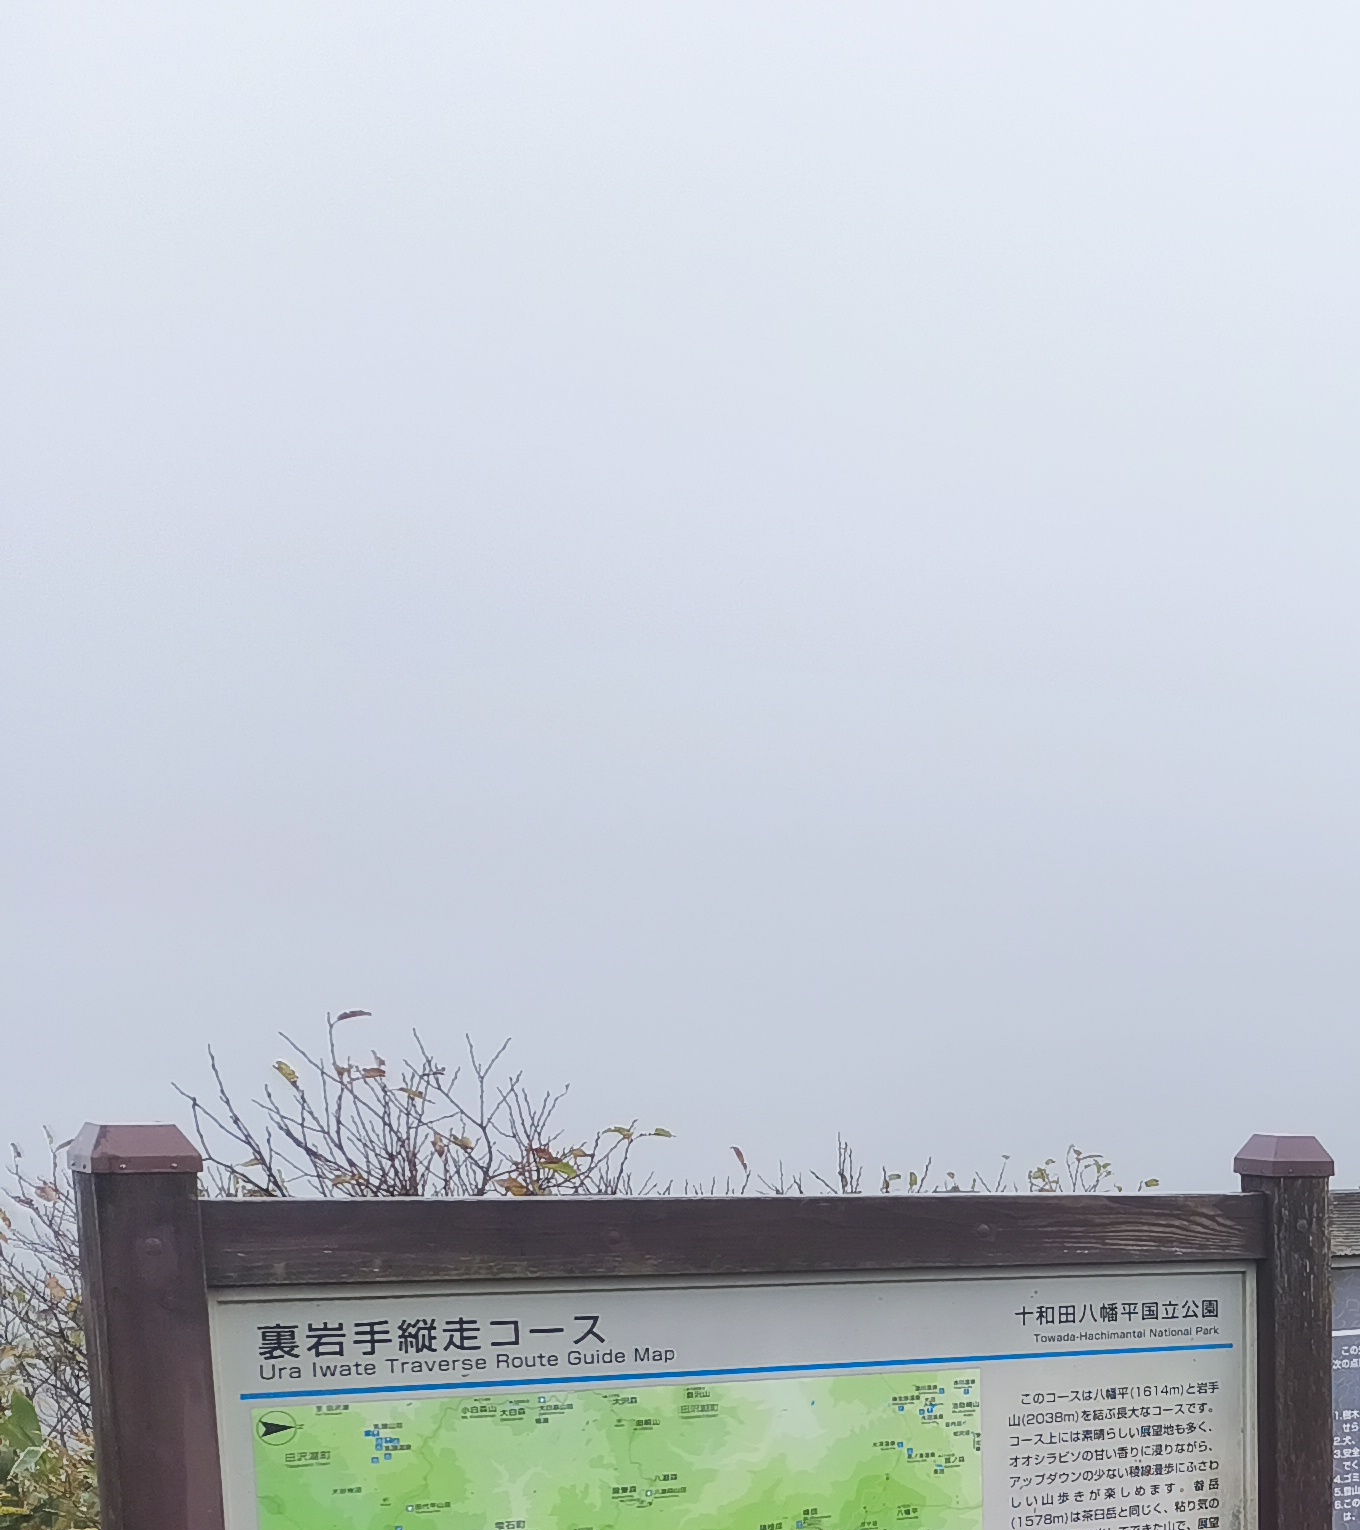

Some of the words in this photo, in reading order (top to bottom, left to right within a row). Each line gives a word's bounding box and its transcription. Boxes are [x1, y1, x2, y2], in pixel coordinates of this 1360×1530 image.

[1015, 1299, 1219, 1326] 十和田八幡平国立公園
[257, 1314, 606, 1360] 裏岩手縦走コース
[1034, 1329, 1146, 1343] Towada-Hachimantai
[1149, 1327, 1192, 1338] National
[1195, 1326, 1220, 1336] Park
[259, 1364, 301, 1381] Ura
[312, 1360, 377, 1378] Iwate
[385, 1356, 487, 1376] Traverse
[496, 1352, 559, 1370] Route
[567, 1349, 626, 1367] Guide
[634, 1346, 676, 1365] Map
[1020, 1381, 1220, 1405] このコースは八幡平(1614m)と岩手
[1008, 1403, 1213, 1427] 山(2038m)を結ぶ長大なコースです。
[1009, 1421, 1213, 1446] コース上には素晴らしい展望地も多く、
